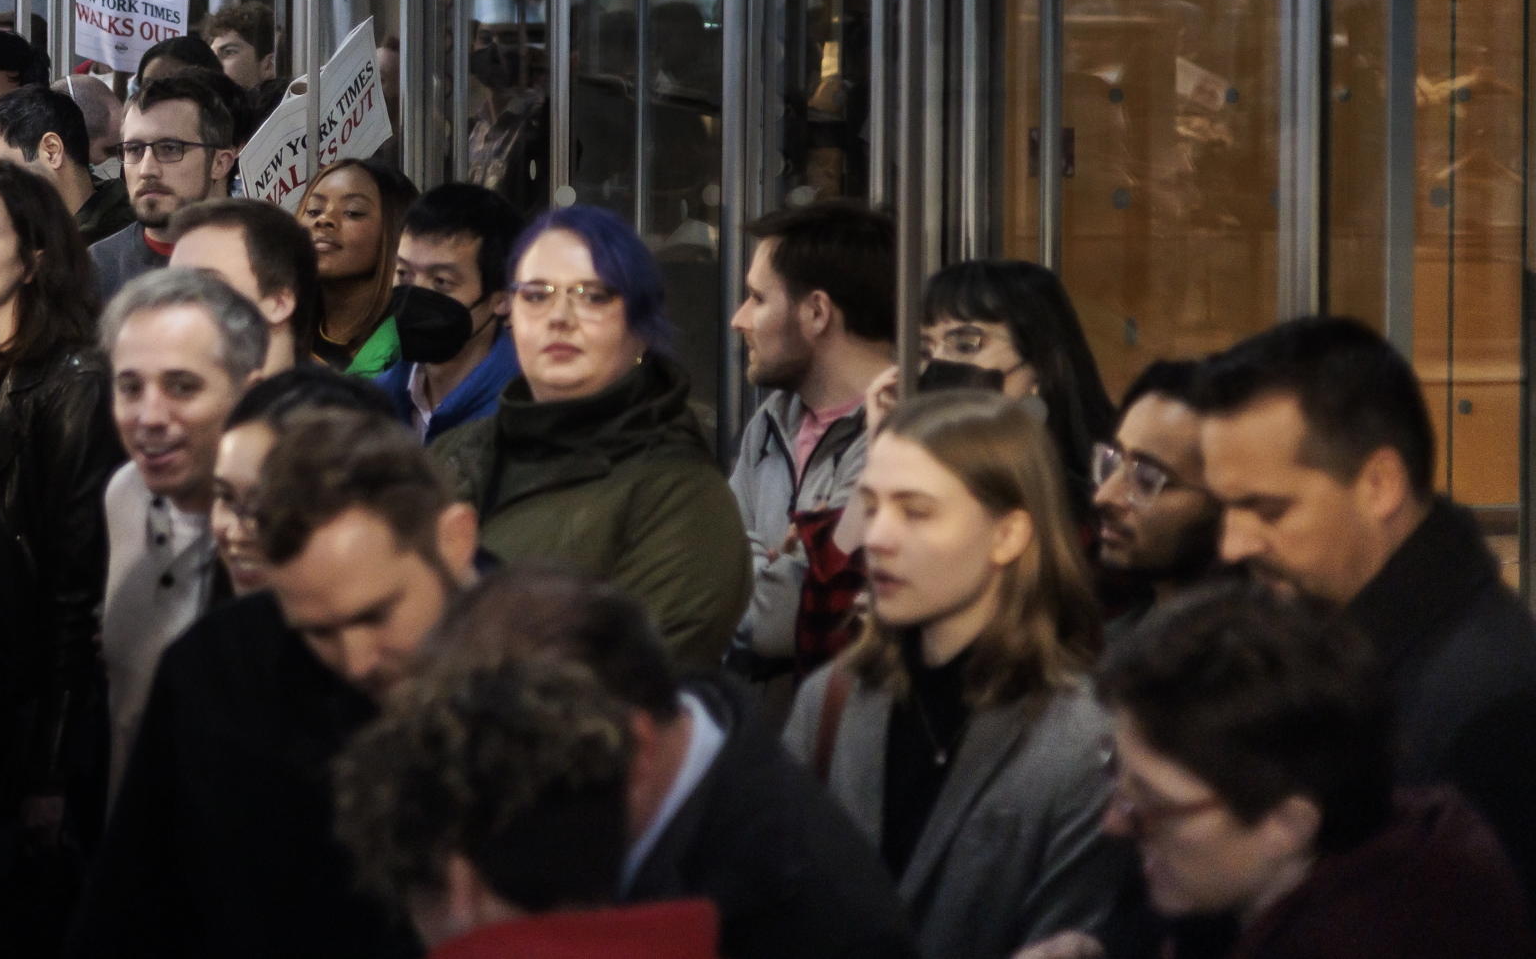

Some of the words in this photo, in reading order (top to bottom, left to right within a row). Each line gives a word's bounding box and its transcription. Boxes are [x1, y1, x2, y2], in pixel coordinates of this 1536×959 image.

[75, 1, 135, 38] WALKS
[141, 1, 181, 25] TIMES
[254, 147, 284, 198] NEW
[335, 61, 375, 117] TIMES
[341, 82, 375, 145] OUT
